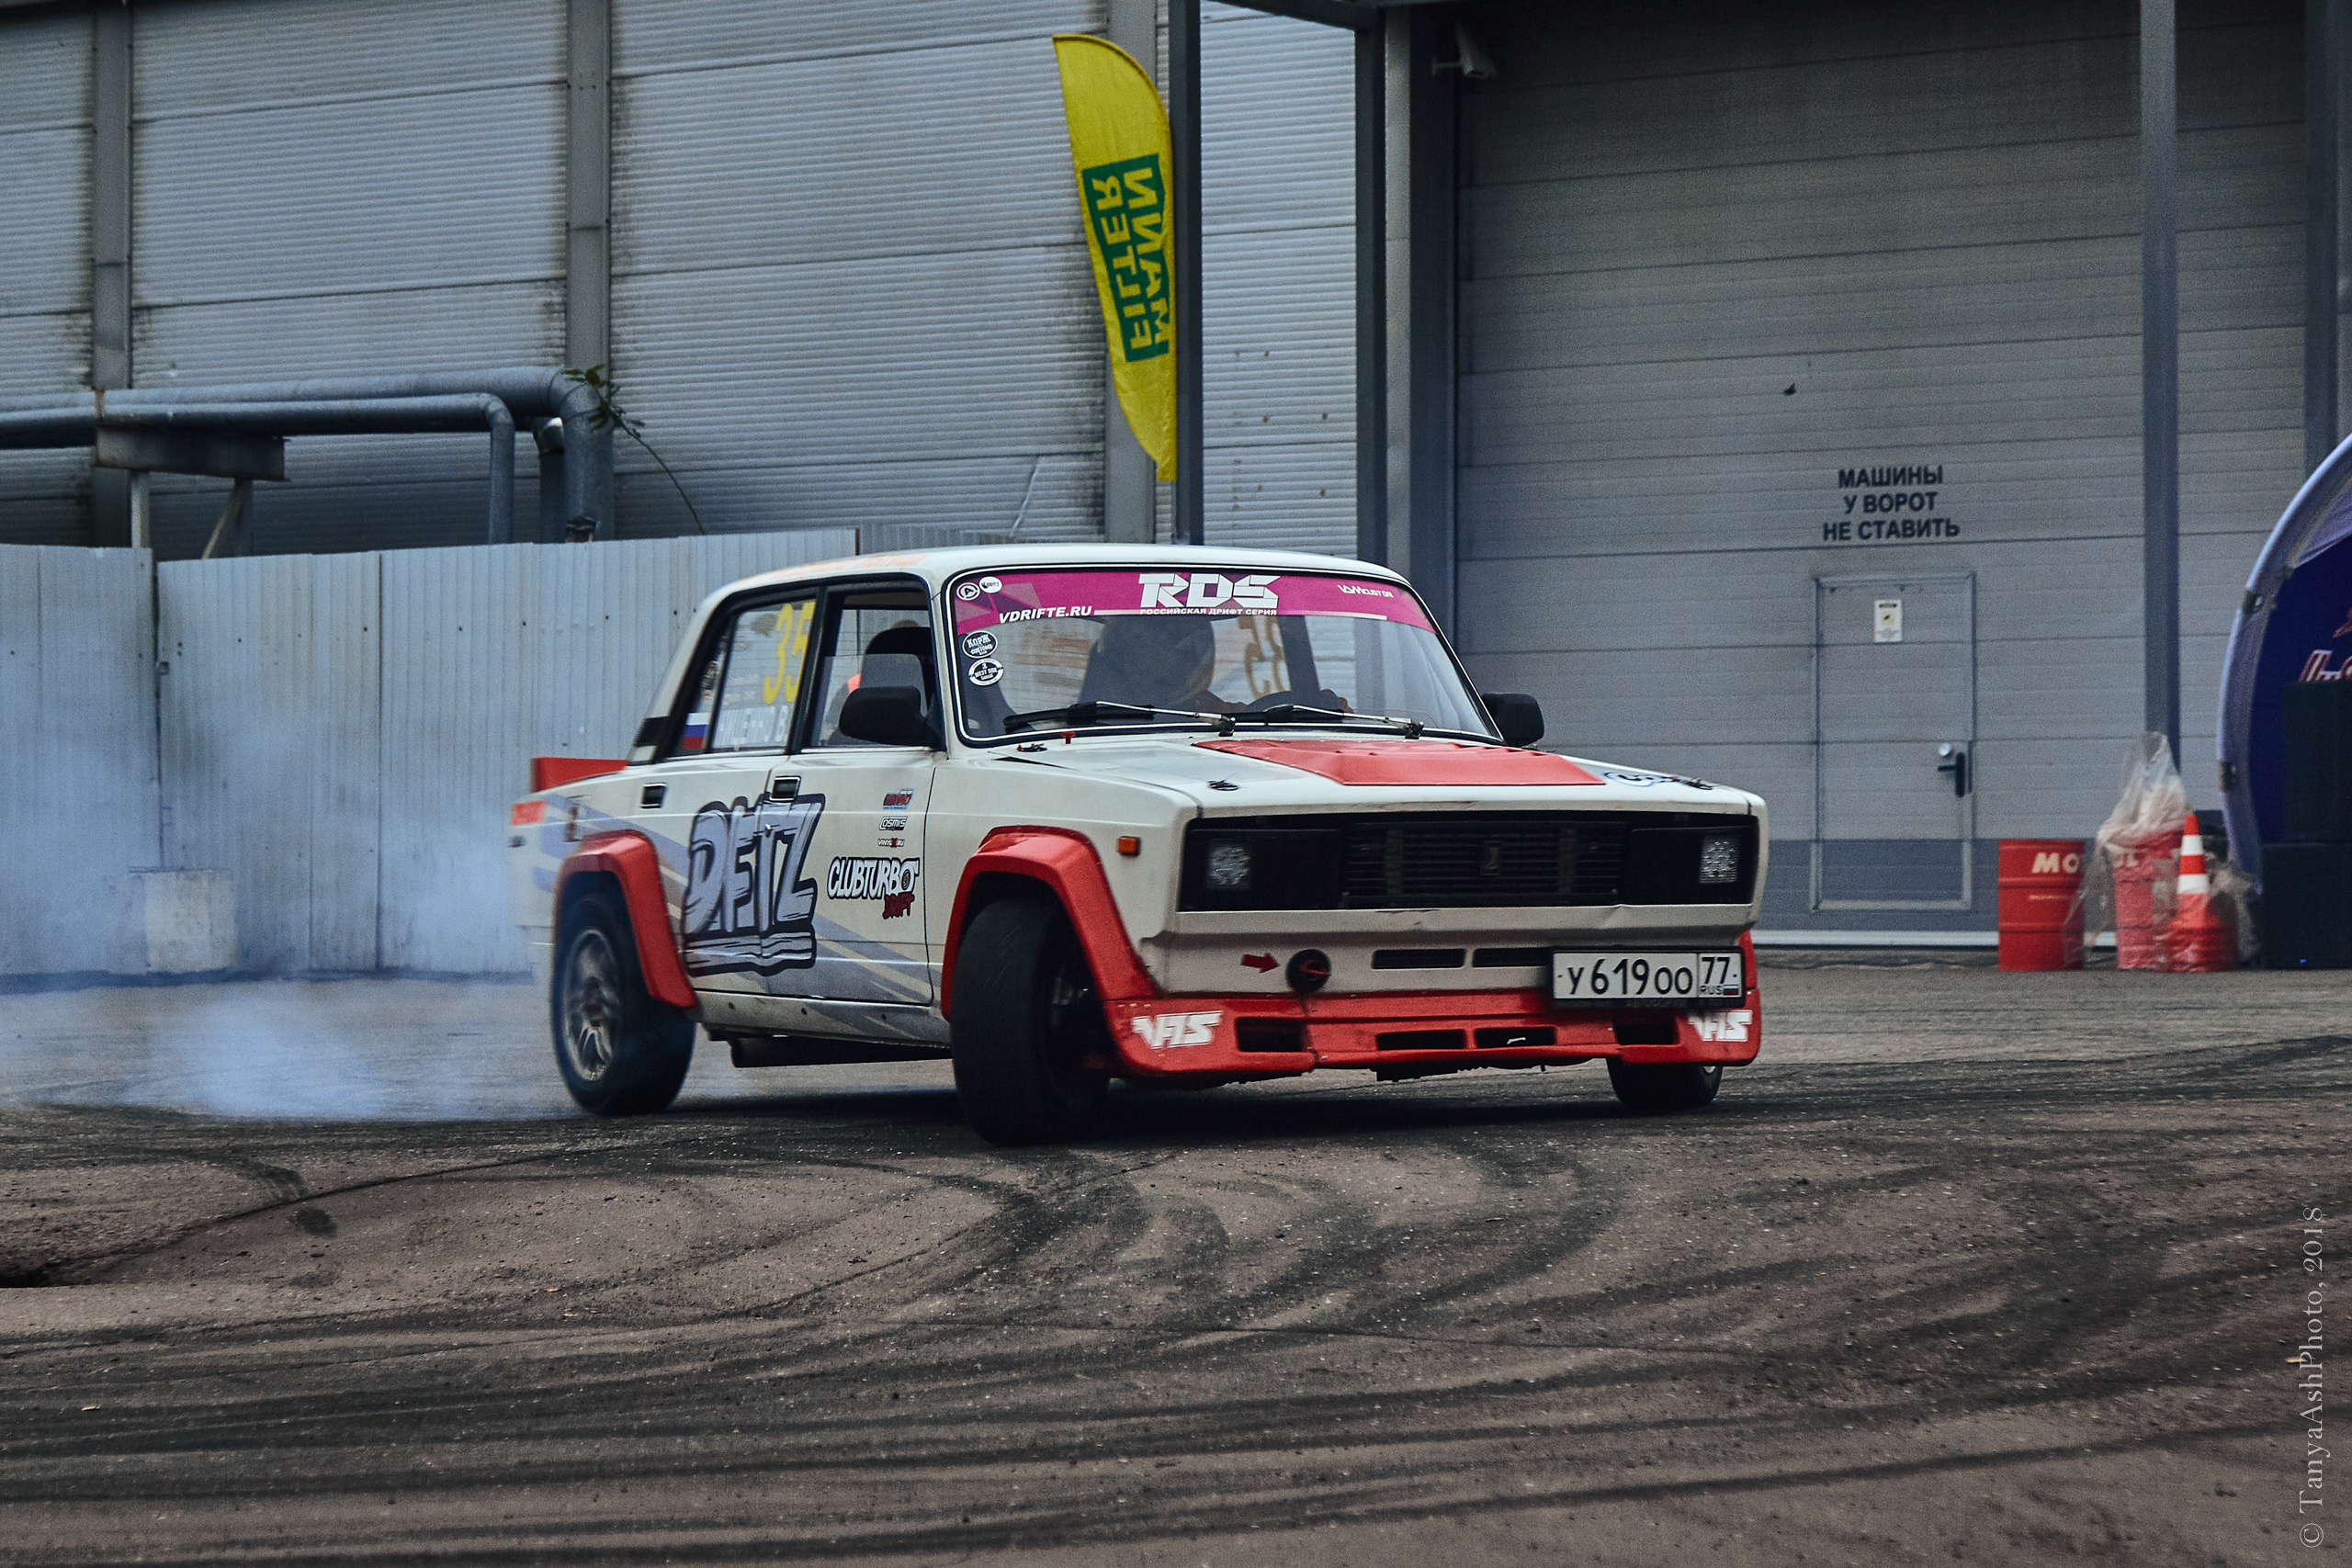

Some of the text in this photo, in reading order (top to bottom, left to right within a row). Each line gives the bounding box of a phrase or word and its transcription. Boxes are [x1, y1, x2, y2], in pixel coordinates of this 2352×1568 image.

[1838, 465, 1943, 488] МАШИНЫ
[1843, 491, 1939, 514] У ВОРОТ
[1823, 518, 1961, 541] НЕ СТАВИТЬ
[1138, 573, 1281, 609] RDS
[999, 605, 1092, 624] VDRIFTE.RU
[763, 601, 817, 705] 35
[827, 856, 920, 900] CLUBTURBO
[882, 892, 915, 919] DRIFT
[1701, 956, 1731, 985] 77
[1700, 985, 1724, 995] RUS
